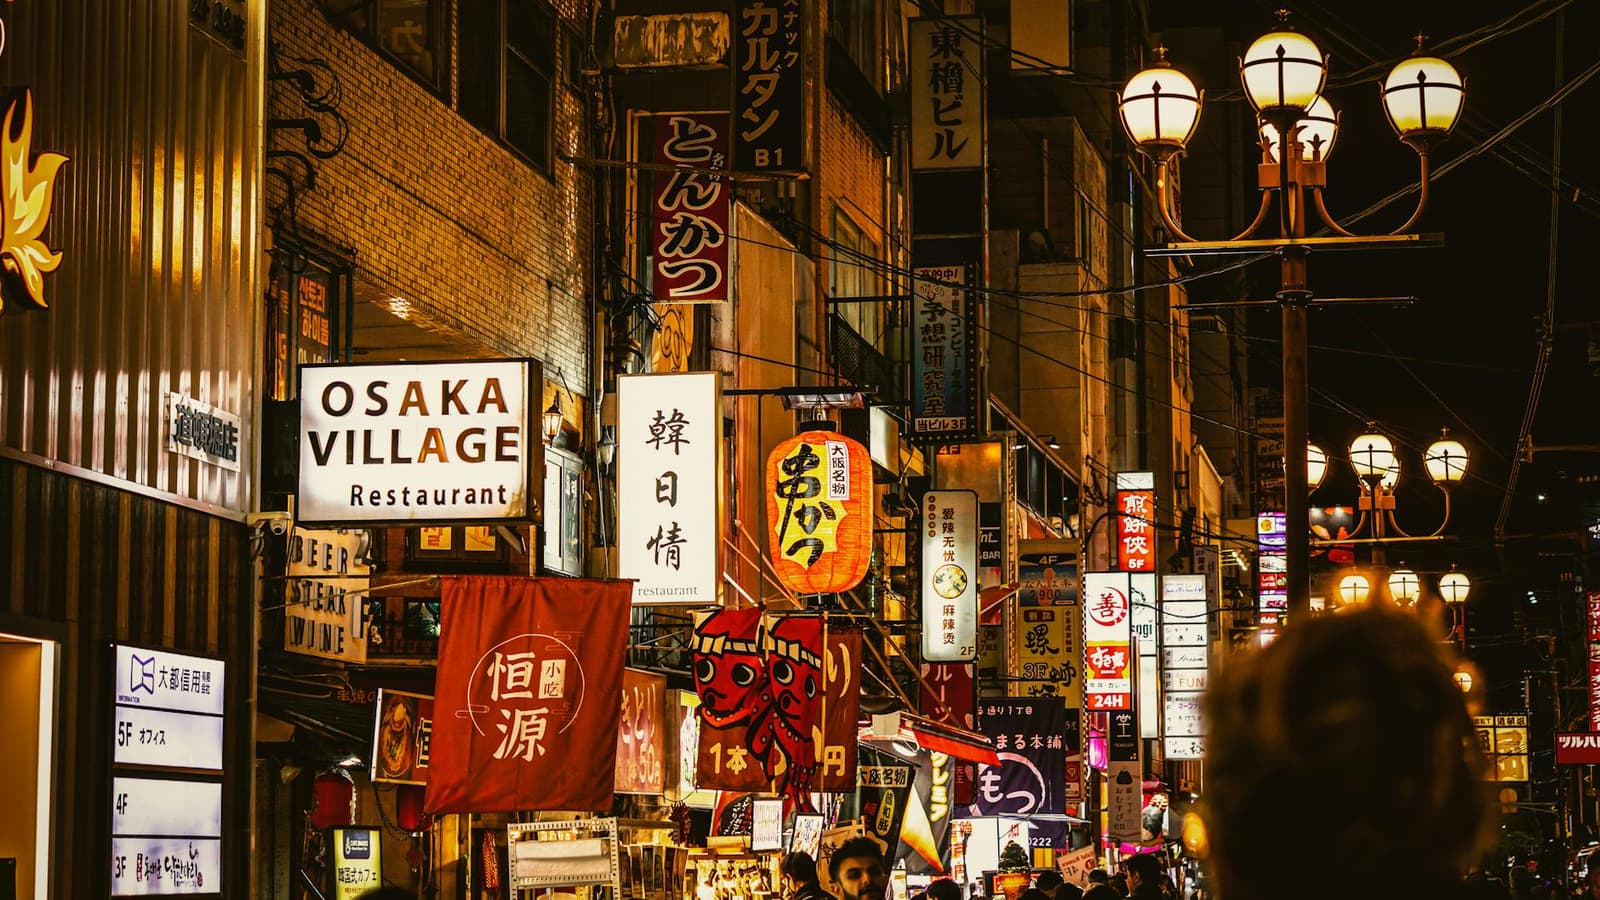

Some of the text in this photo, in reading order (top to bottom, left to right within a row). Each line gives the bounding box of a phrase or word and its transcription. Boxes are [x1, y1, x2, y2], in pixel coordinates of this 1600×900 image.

[741, 2, 780, 142] カルダン
[928, 26, 967, 160] 東櫓ビル
[755, 148, 783, 167] B1
[658, 116, 725, 297] とんかつ
[920, 302, 946, 416] 予想研究室
[321, 377, 508, 417] OSAKA
[307, 426, 519, 466] VILLAGE
[646, 408, 690, 571] 韓日情
[831, 445, 845, 495] 大阪名物
[350, 483, 507, 507] Restaurant
[776, 443, 836, 567] 串かつ
[291, 534, 348, 574] BEER
[942, 507, 955, 562] 爱辣无忧
[288, 578, 346, 614] STEAK
[638, 586, 698, 597] restaurant
[1092, 592, 1121, 618] 善
[289, 615, 345, 654] WINE
[942, 604, 955, 645] 麻辣烫
[960, 646, 974, 655] 2F
[1090, 647, 1125, 670] すき家
[543, 662, 560, 697] 小吃
[1023, 662, 1048, 680] 3F
[486, 652, 549, 762] 恒源
[1094, 694, 1123, 708] 24H
[118, 721, 166, 746] 5F オフィス
[709, 742, 748, 775] 1本
[117, 793, 128, 815] 4F
[980, 770, 1036, 813] もつ
[115, 855, 126, 878] 3F
